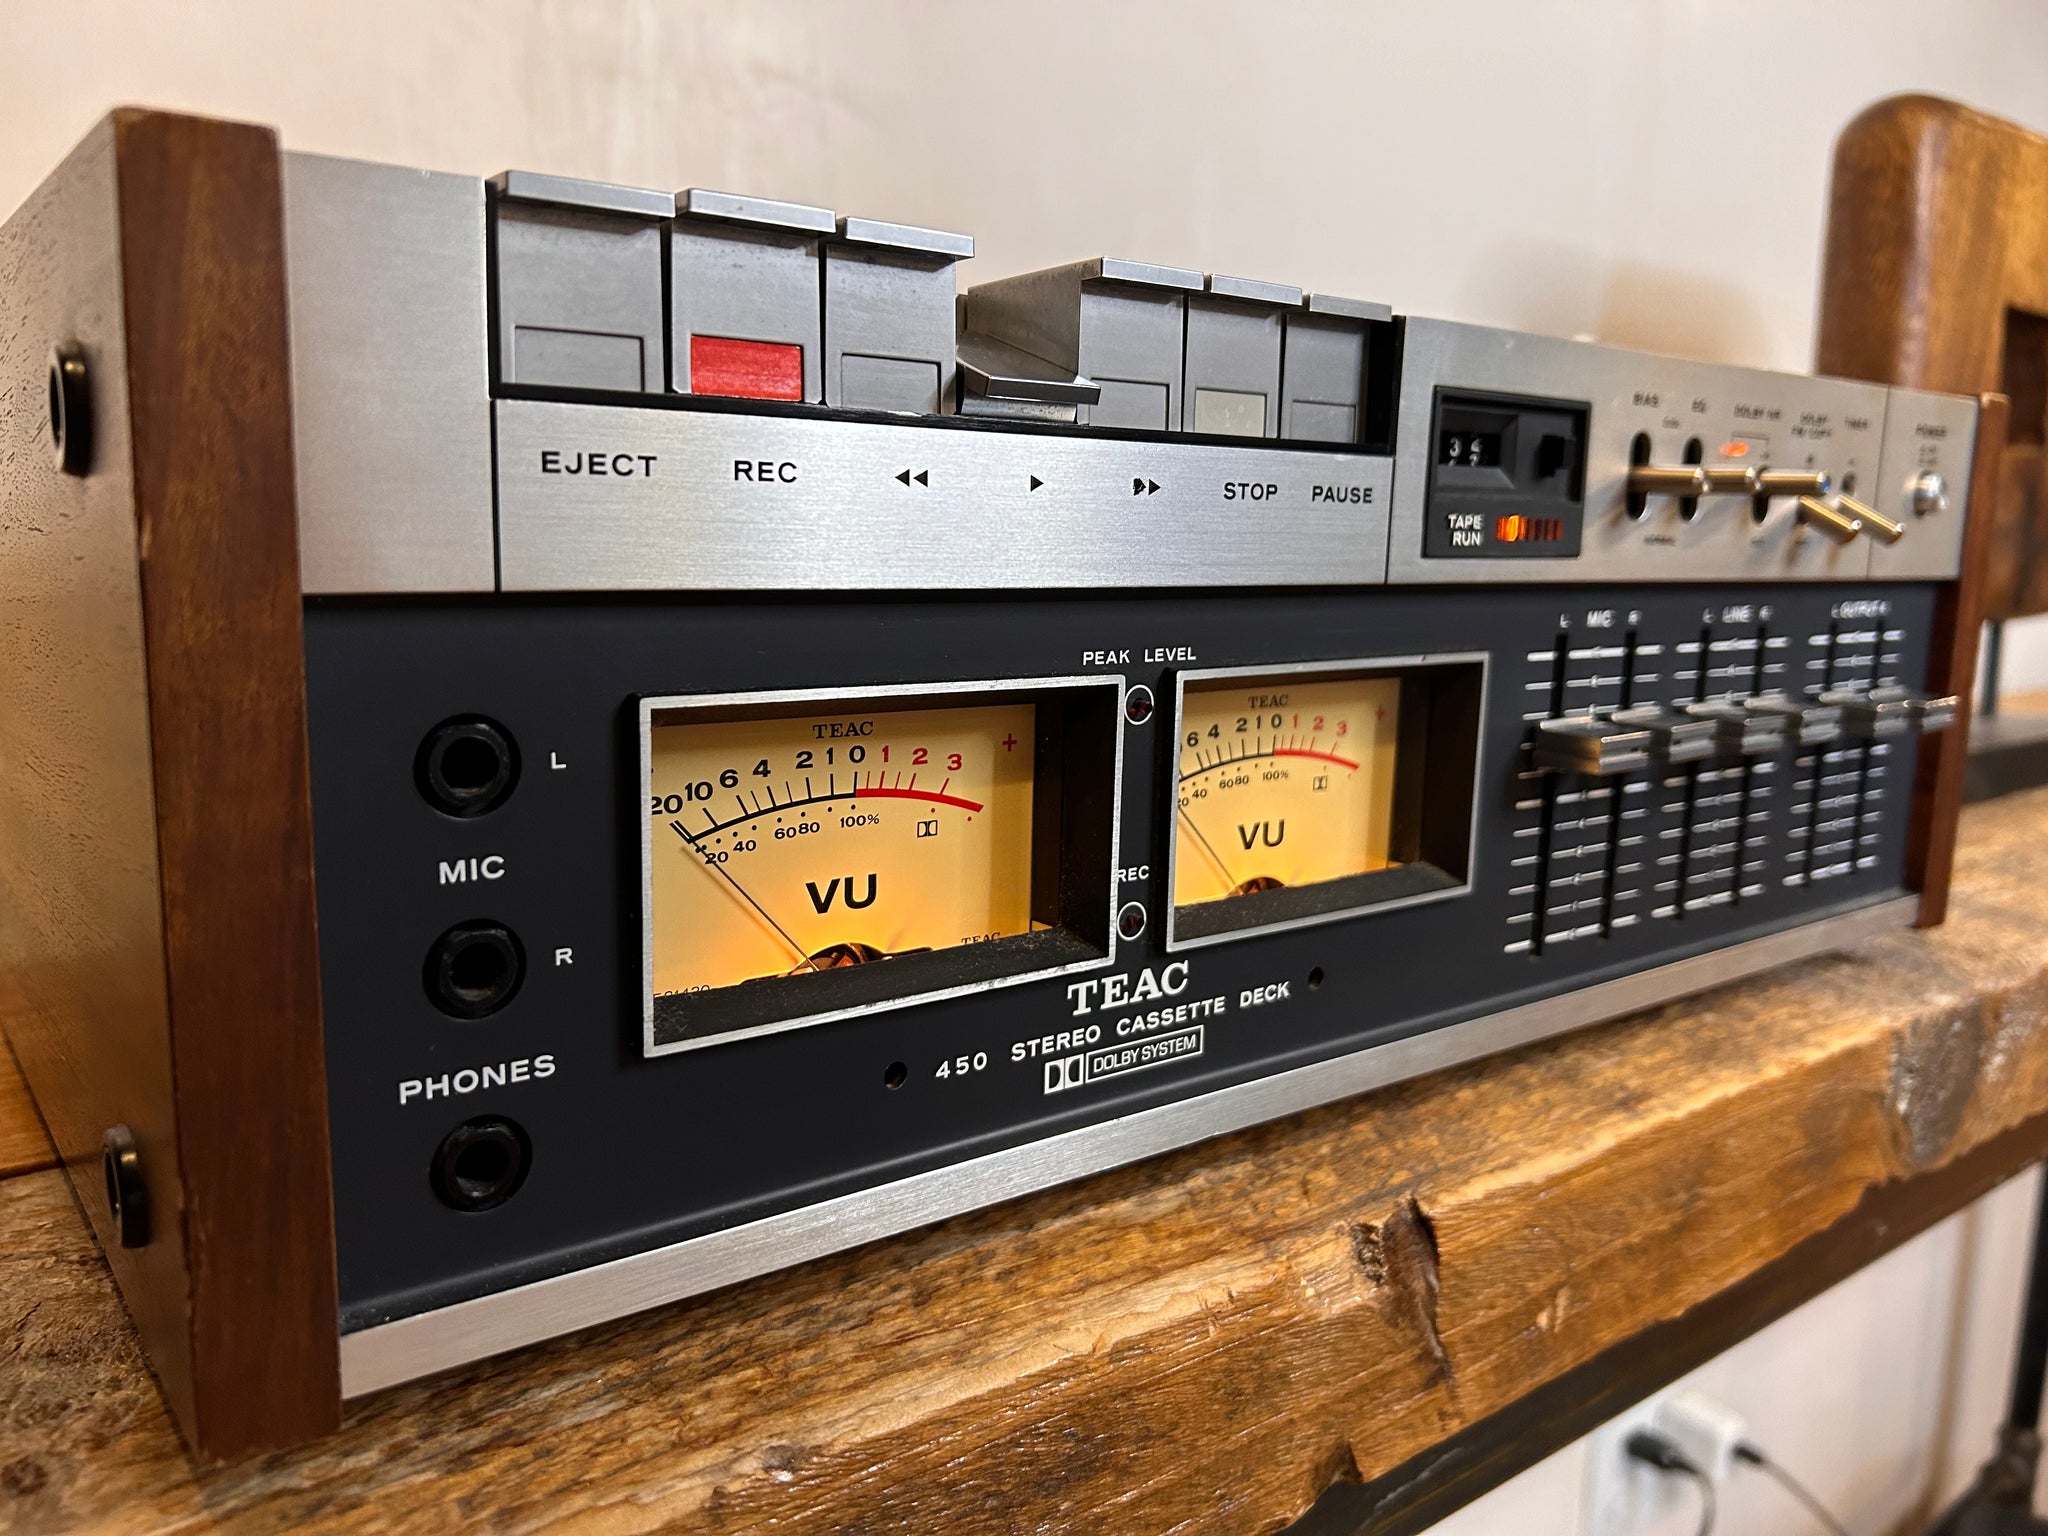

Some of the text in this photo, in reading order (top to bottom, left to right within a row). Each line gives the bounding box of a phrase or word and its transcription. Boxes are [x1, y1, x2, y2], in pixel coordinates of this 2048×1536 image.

[541, 450, 658, 477] EJECT
[733, 460, 797, 484] REC
[1223, 482, 1278, 500] STOP
[1312, 486, 1373, 504] PAUSE
[1448, 514, 1484, 530] TAPE
[1452, 531, 1482, 546] RUN
[1586, 609, 1616, 628] MIC
[1082, 647, 1197, 665] PEAK LEVEL
[1248, 694, 1289, 709] TEAC
[813, 721, 874, 739] TEAC
[1186, 714, 1347, 747] 6 4 2 1 0 1 2 3
[550, 752, 567, 770] L
[685, 781, 713, 801] 10
[719, 769, 739, 788] 6
[752, 759, 771, 777] 4
[795, 751, 813, 769] 2
[826, 747, 834, 765] 1
[849, 745, 866, 763] 0
[882, 745, 890, 763] 1
[912, 748, 928, 765] 2
[947, 753, 962, 771] 3
[1192, 788, 1207, 798] 40
[1219, 779, 1234, 789] 60
[1235, 775, 1249, 785] 80
[1262, 770, 1289, 781] 100%
[705, 813, 880, 864] 20 40 60 80 100%
[1238, 819, 1285, 850] VU
[439, 855, 506, 885] MIC
[1118, 865, 1150, 882] REC
[806, 873, 877, 915] VU
[554, 947, 573, 966] R
[1067, 960, 1190, 1016] TEAC
[936, 981, 1291, 1080] 450 STEREO CASSETTE DECK
[1093, 1031, 1197, 1074] DOLBY SYSTEM
[399, 1053, 557, 1106] PHONES
